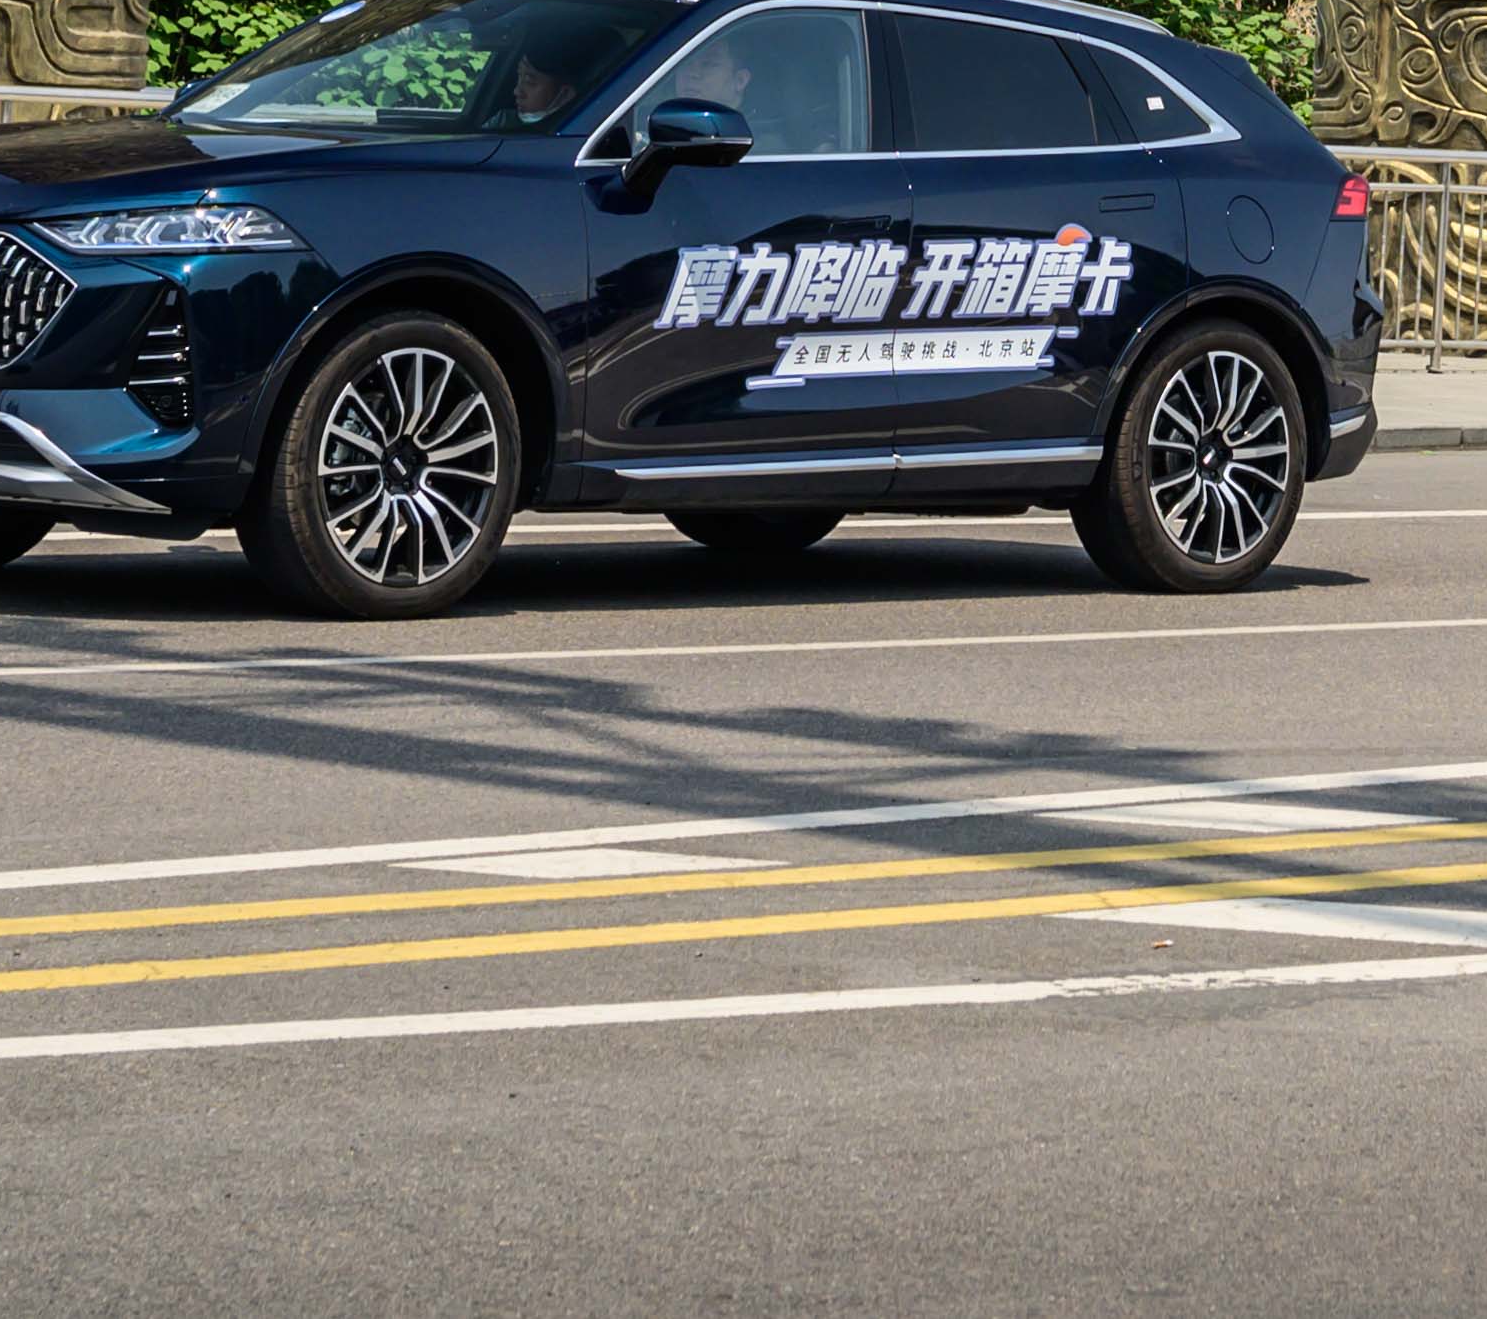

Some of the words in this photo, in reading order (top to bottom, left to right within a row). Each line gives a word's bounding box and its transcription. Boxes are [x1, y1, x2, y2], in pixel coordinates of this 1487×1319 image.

[654, 239, 907, 328] 摩力降临
[900, 231, 1132, 320] 开箱摩卡
